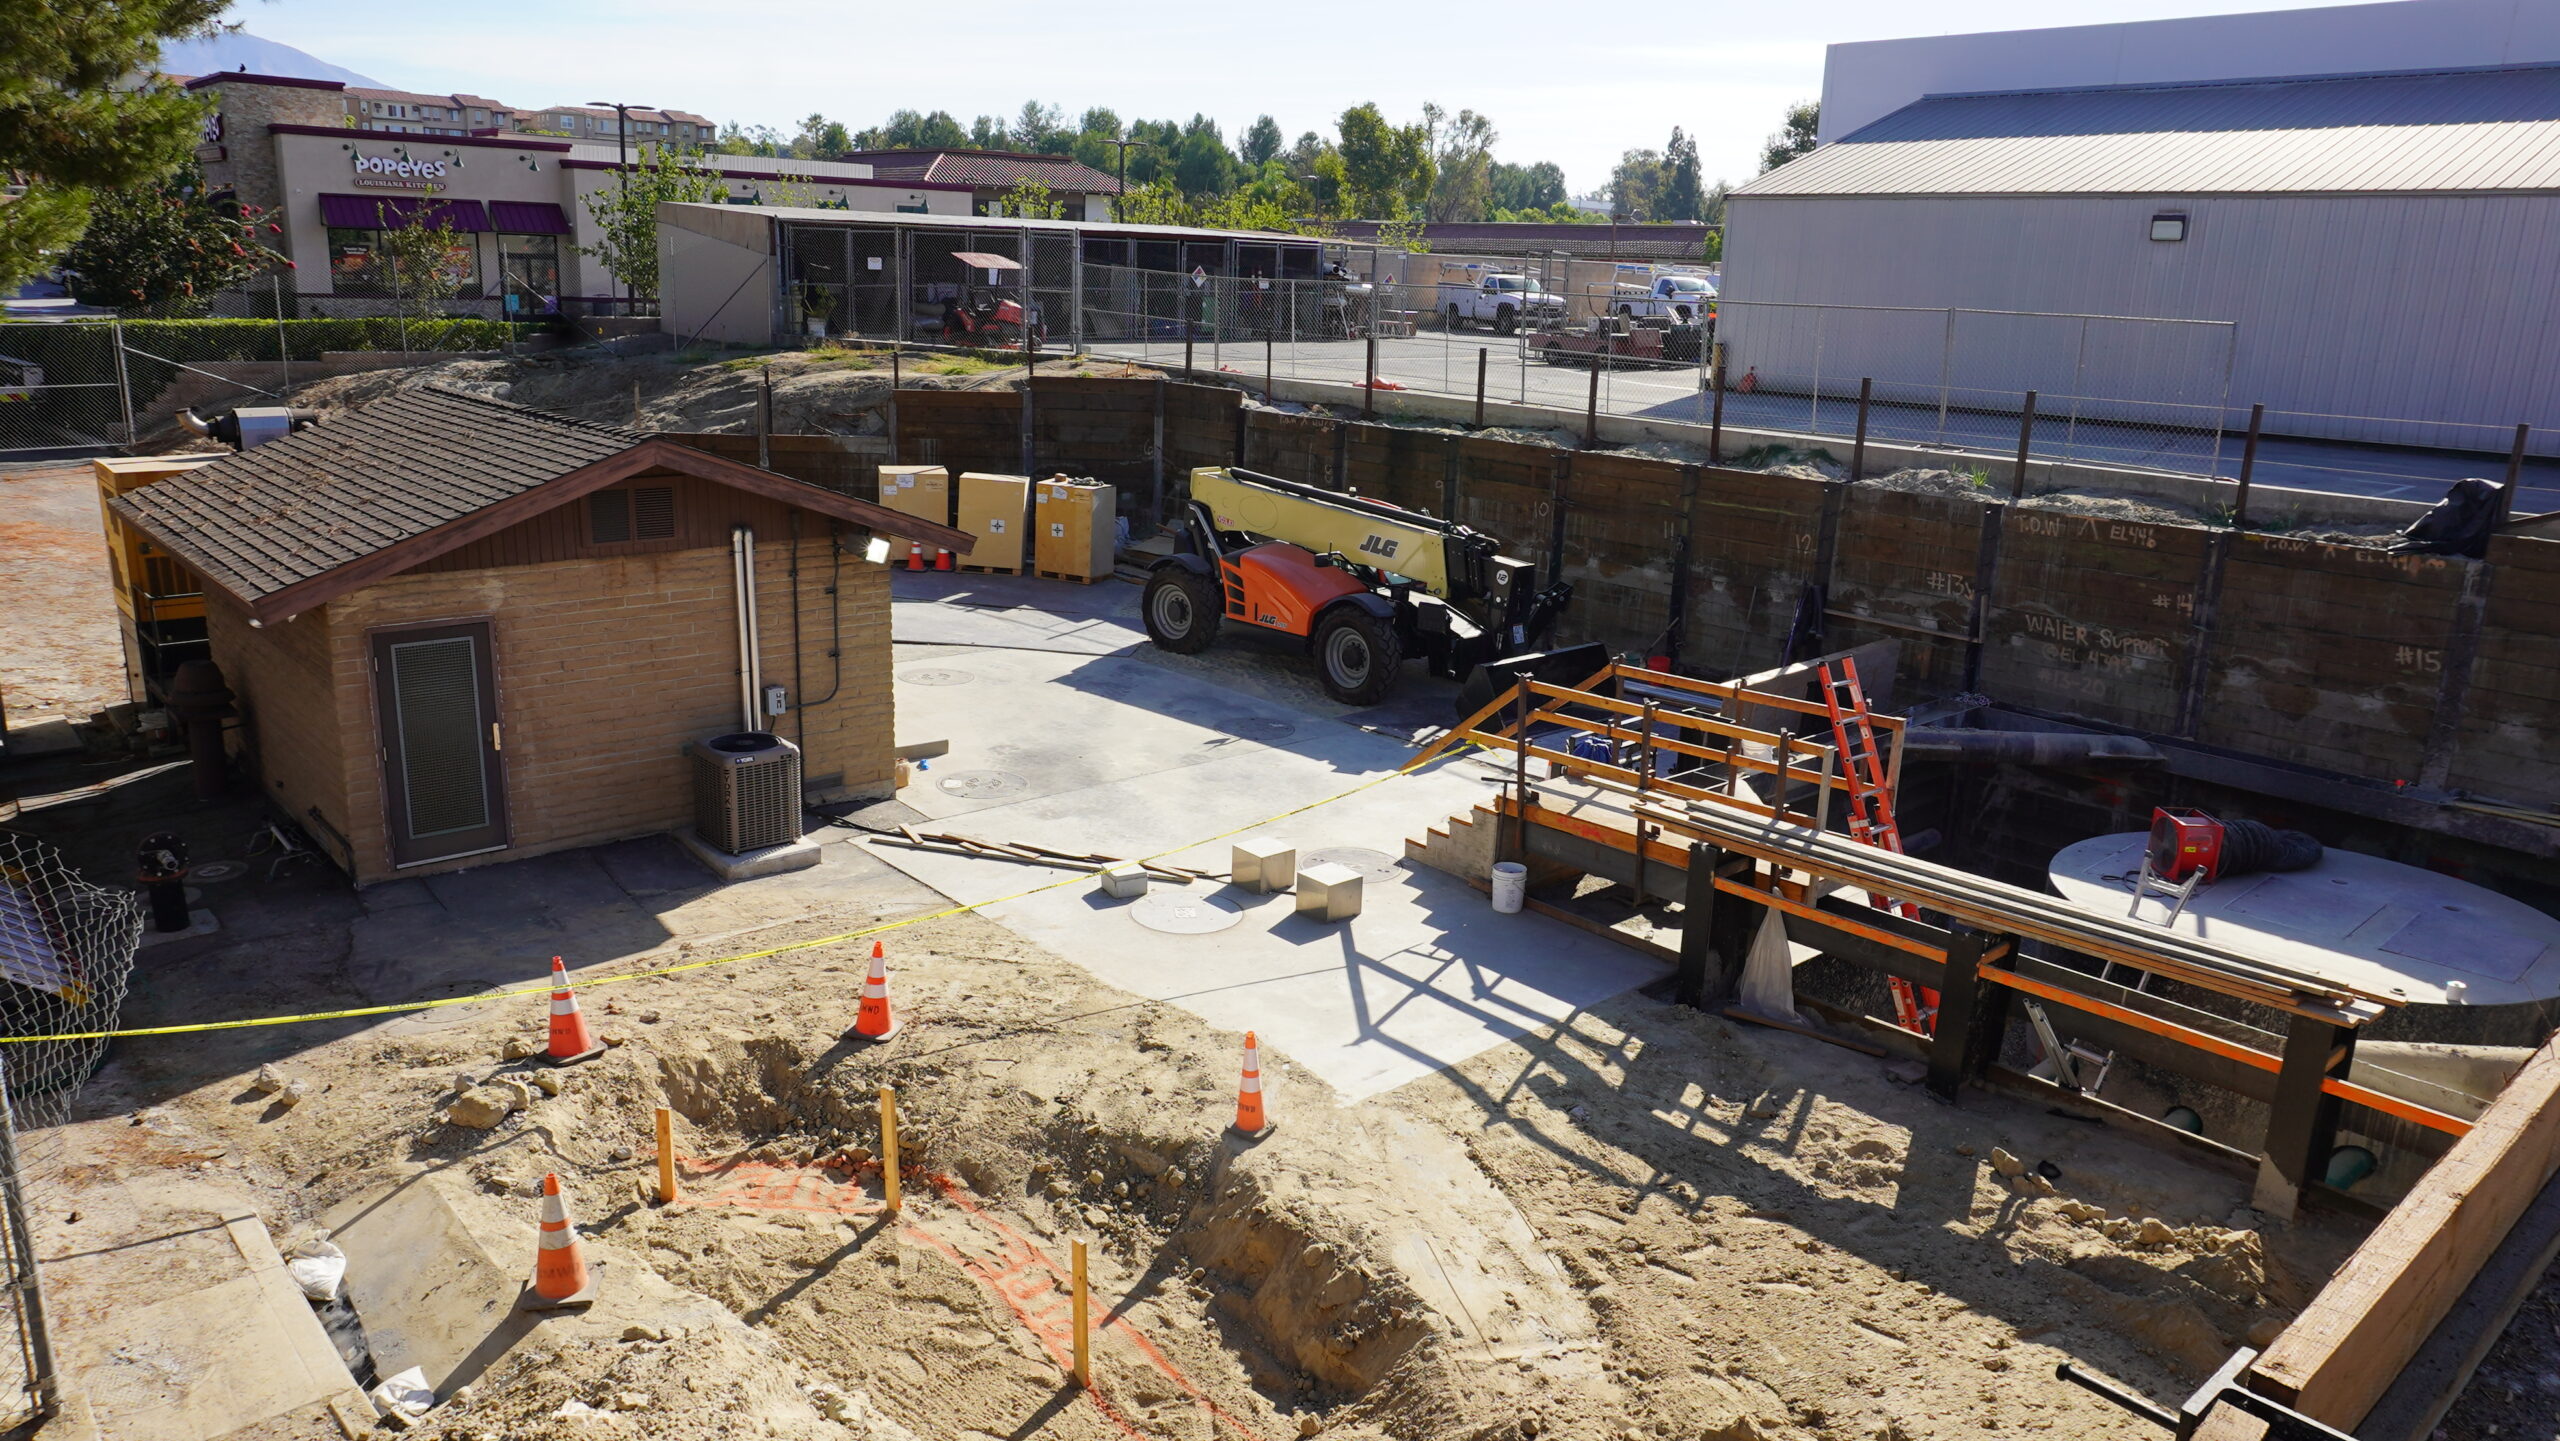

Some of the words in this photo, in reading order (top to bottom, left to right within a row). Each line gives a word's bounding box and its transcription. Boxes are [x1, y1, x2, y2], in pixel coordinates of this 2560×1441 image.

[359, 180, 403, 188] LOUISIANA
[406, 181, 445, 190] KITCEN
[1360, 535, 1399, 559] JLG
[1795, 534, 1811, 555] 12
[1259, 615, 1276, 626] JLG
[2395, 646, 2441, 673] #15
